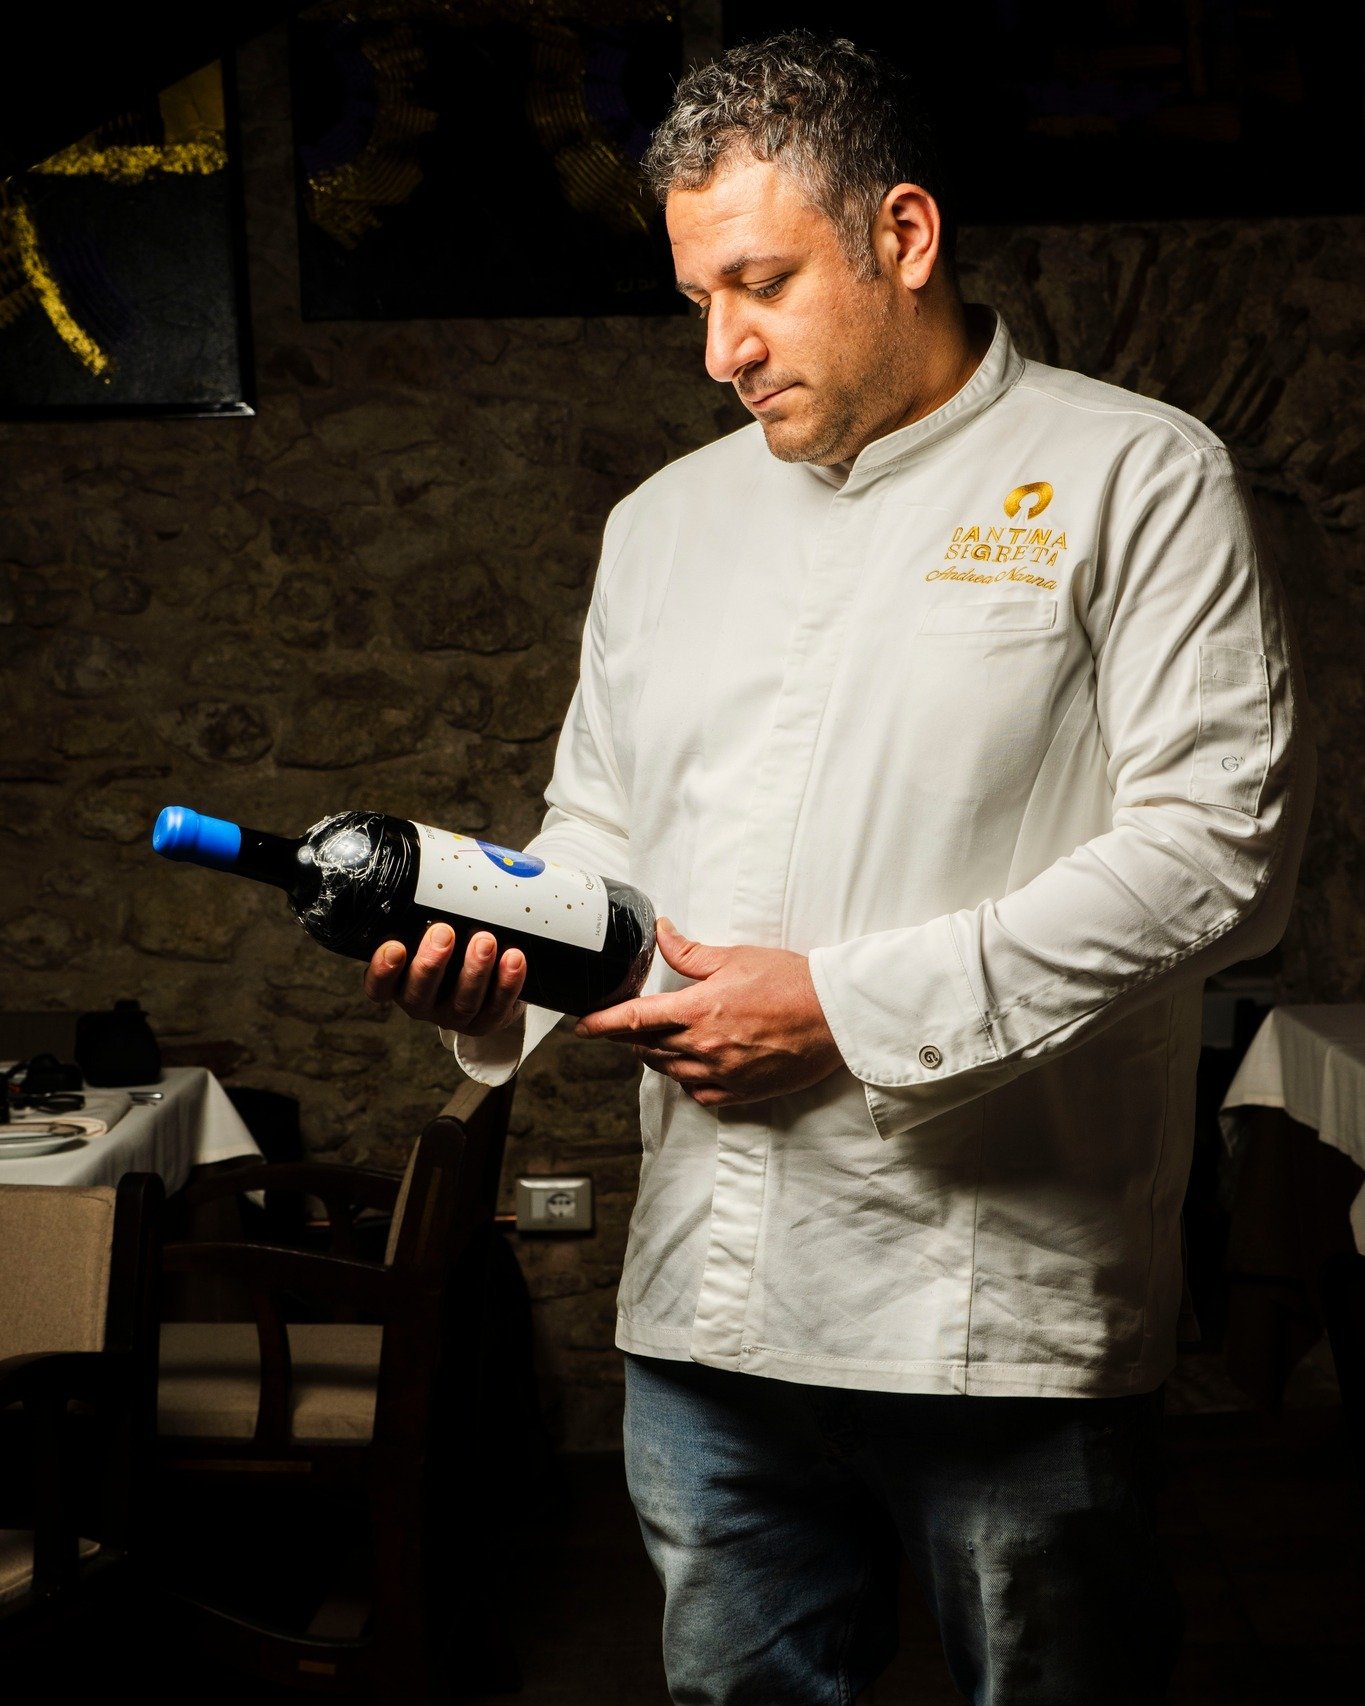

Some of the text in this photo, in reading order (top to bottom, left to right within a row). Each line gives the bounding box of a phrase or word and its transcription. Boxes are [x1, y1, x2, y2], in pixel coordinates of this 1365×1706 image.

[952, 525, 1067, 550] CANTINA
[944, 543, 1059, 567] SEGRETA
[925, 565, 1058, 590] Andrea Nanna
